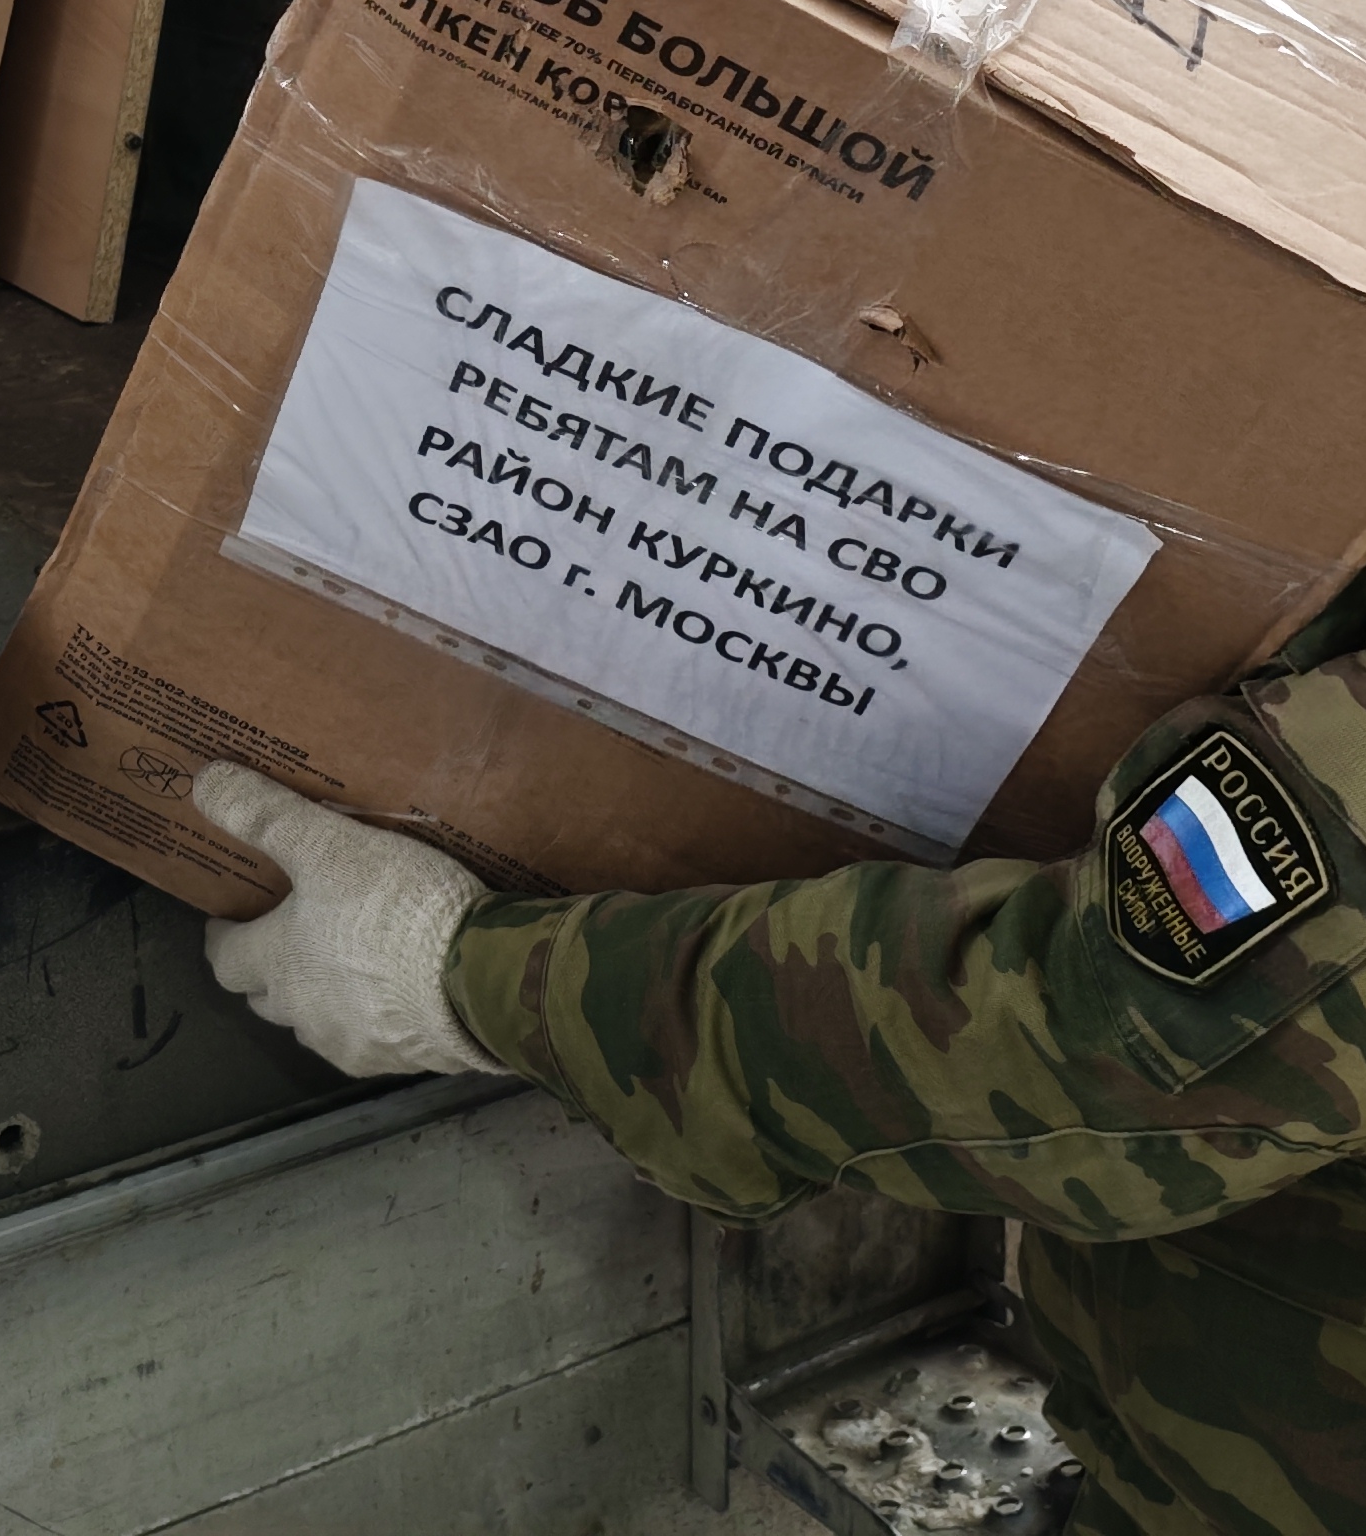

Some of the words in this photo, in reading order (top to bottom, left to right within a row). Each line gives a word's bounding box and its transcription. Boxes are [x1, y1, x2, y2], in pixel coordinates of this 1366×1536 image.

[561, 35, 605, 66] 70%
[603, 56, 787, 161] ПЕРЕРАБОТАННОЙ
[781, 151, 867, 205] БУМАГИ
[616, 10, 935, 202] БОЛЬШОЙ
[435, 286, 715, 433] СЛАДКИЕ
[724, 417, 1020, 569] ПОДАРКИ
[448, 360, 719, 505] РЕБЯТАМ
[728, 489, 806, 551] НА
[827, 537, 947, 601] СВО
[74, 622, 95, 642] ТУ
[408, 492, 552, 570] СЗАО
[562, 563, 596, 597] г.
[615, 580, 876, 717] МОСКВЫ
[417, 425, 616, 535] РАЙОН
[627, 520, 908, 671] КУРКИНО,
[55, 710, 75, 730] 20
[1115, 823, 1208, 965] ВООРУЖЕННЫЕ
[1200, 743, 1316, 901] РОССИЯ
[1117, 877, 1156, 940] СИЛЫ
